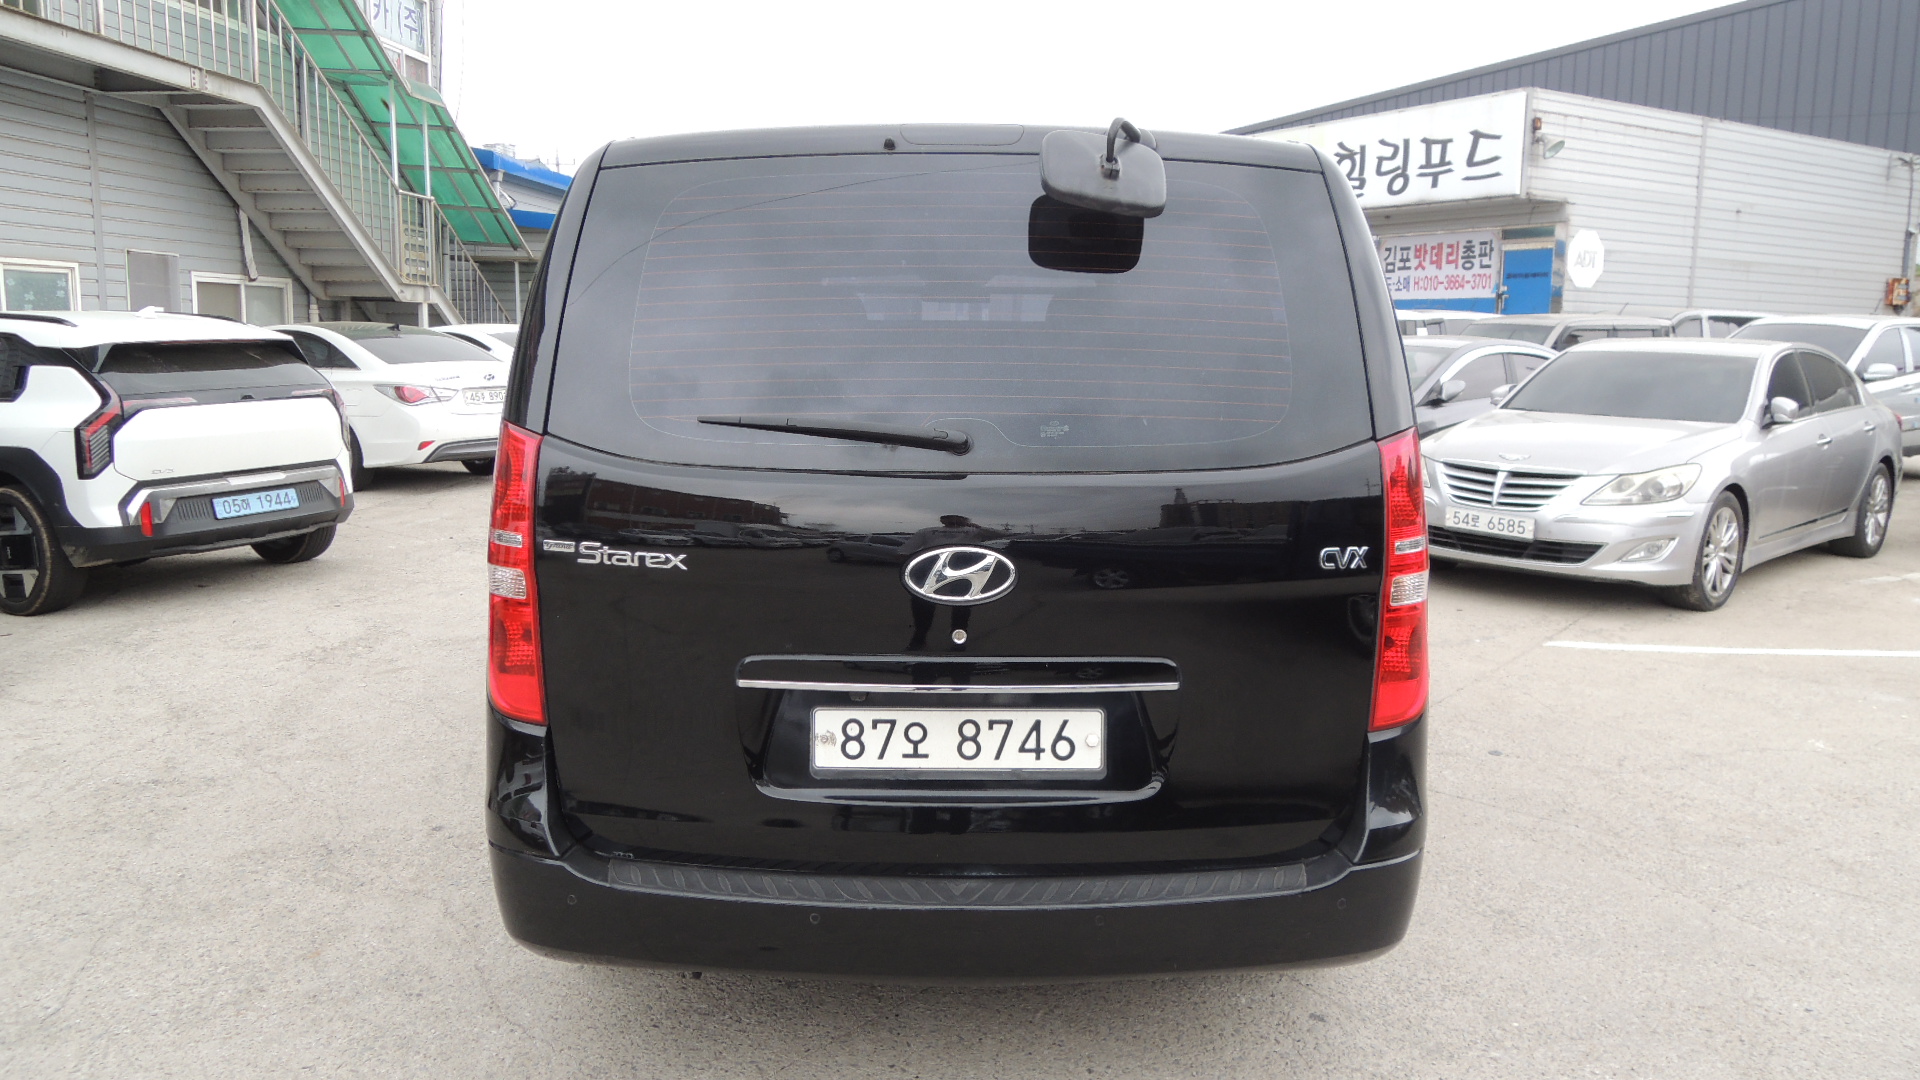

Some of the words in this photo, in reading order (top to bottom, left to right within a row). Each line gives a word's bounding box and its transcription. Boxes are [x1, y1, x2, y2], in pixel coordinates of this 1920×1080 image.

[1334, 129, 1503, 198] 힐링푸드
[1573, 250, 1598, 269] ADT
[257, 492, 292, 509] 1944
[1453, 510, 1480, 528] 54로
[1487, 516, 1526, 535] 6585
[577, 541, 688, 570] Starex
[1319, 546, 1370, 569] CVX
[840, 718, 929, 761] 87오
[956, 718, 1076, 761] 8746
